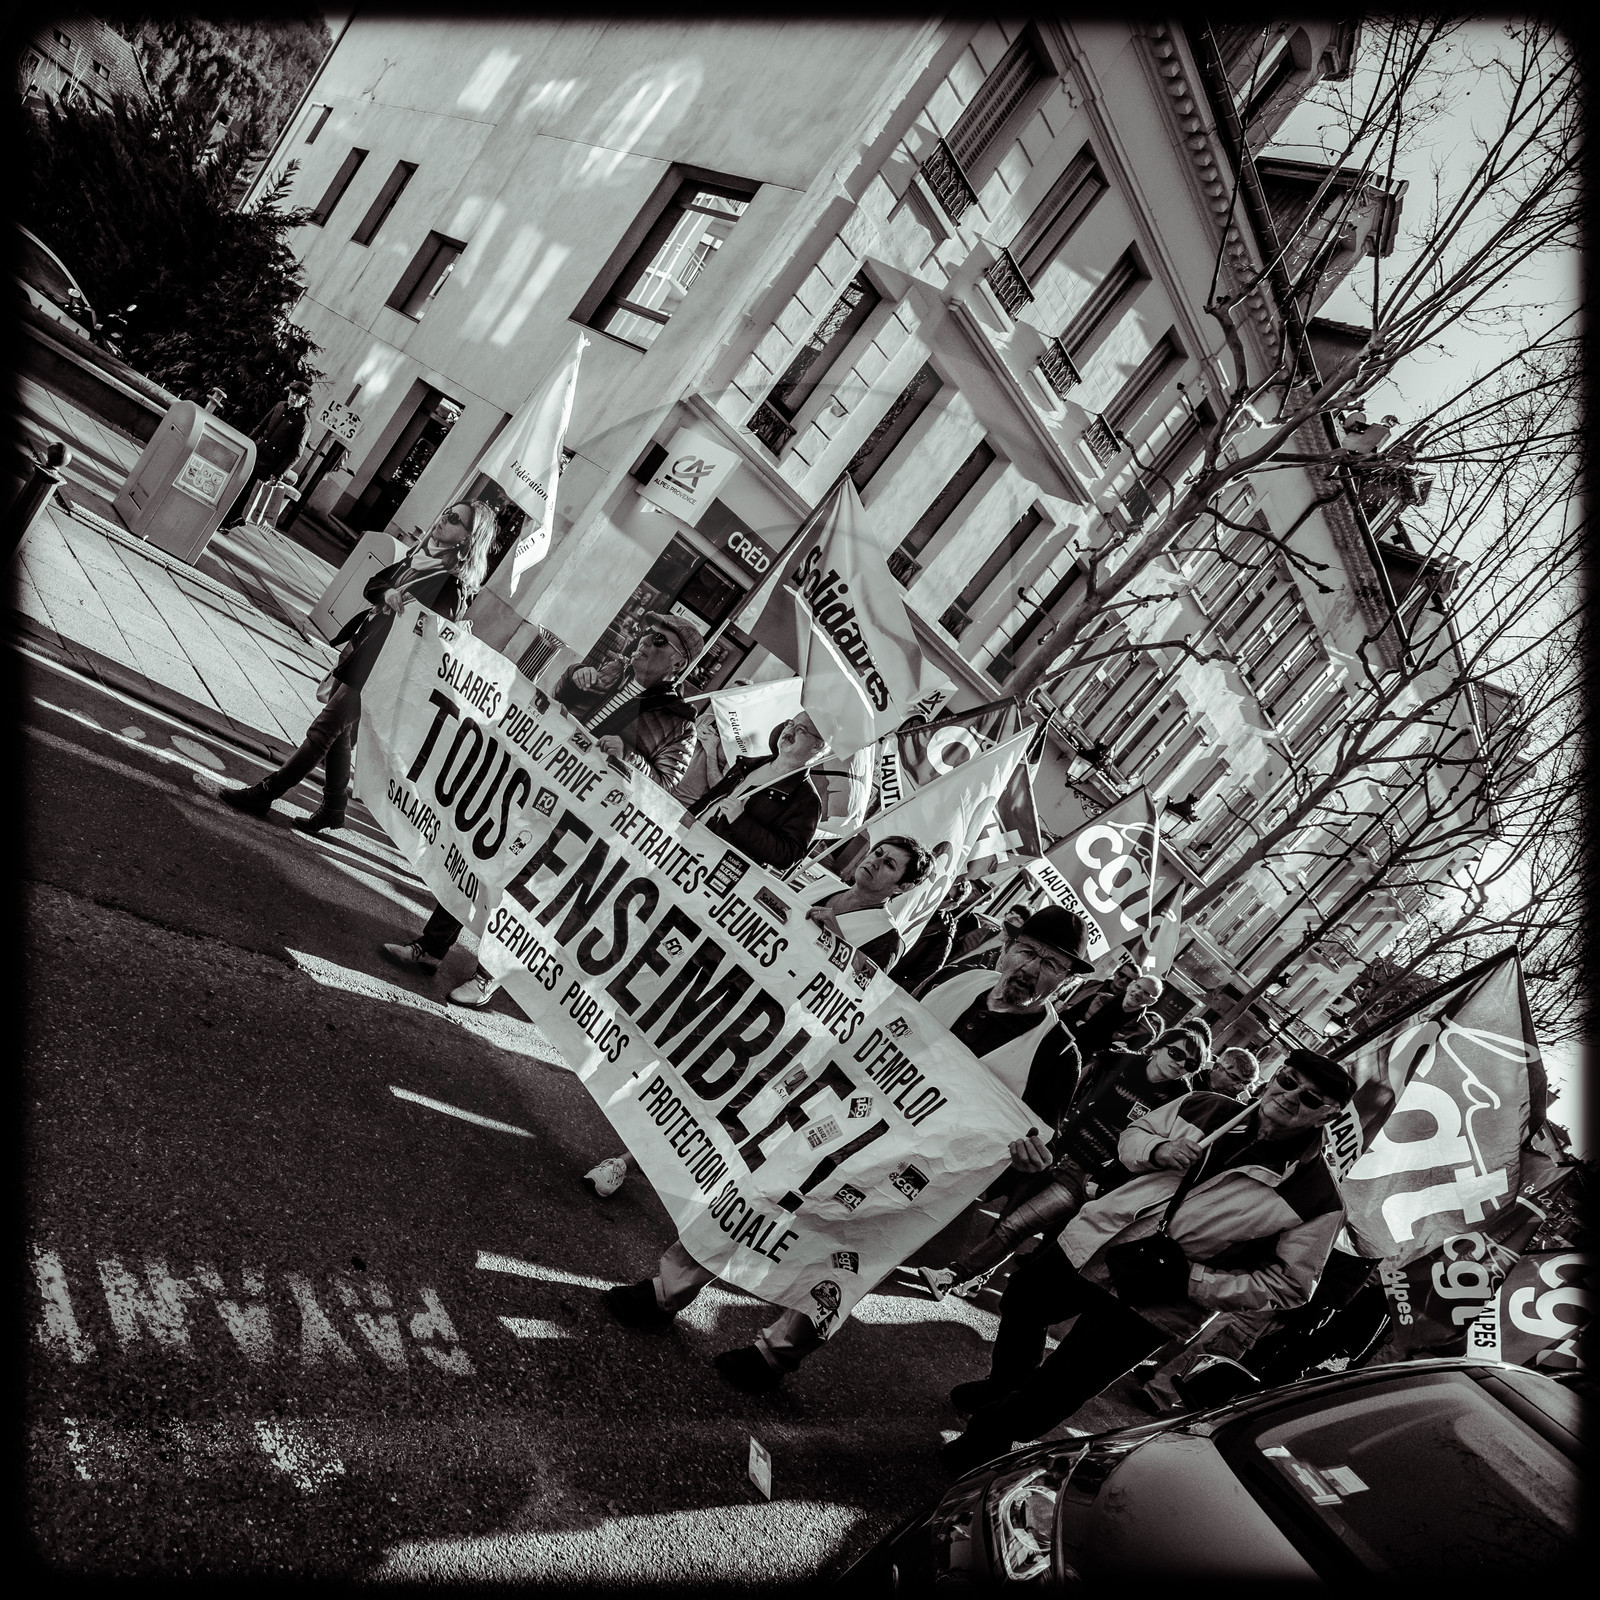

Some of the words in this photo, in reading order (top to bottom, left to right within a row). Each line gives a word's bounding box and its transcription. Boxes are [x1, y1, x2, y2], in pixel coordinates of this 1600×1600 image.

[510, 460, 549, 501] Fédération
[654, 477, 670, 490] ALPES
[669, 485, 697, 506] PROVENCE
[791, 545, 889, 712] Solidaires
[728, 711, 748, 753] Fédération
[539, 793, 555, 808] FO
[437, 652, 502, 719] SALARIÉS
[611, 803, 706, 895] RETRAITÉS
[708, 892, 789, 968] JEUNES
[797, 971, 865, 1045] PRIVÉS
[853, 1028, 948, 1128] D'EMPLOI
[406, 688, 532, 860] TOUS
[504, 808, 857, 1174] ENSEMBLE
[835, 942, 850, 962] FO
[387, 778, 441, 846] SALAIRES
[443, 842, 479, 903] EMPLOI
[487, 908, 564, 991] SERVICES
[559, 980, 630, 1064] PUBLICS
[638, 1075, 729, 1196] PROTECTION
[708, 1179, 799, 1264] SOCIALE
[856, 1097, 868, 1118] cgt
[838, 1188, 862, 1208] cgt
[896, 1177, 920, 1200] cgt
[838, 1252, 854, 1272] cgt
[1386, 1267, 1414, 1326] Alpes
